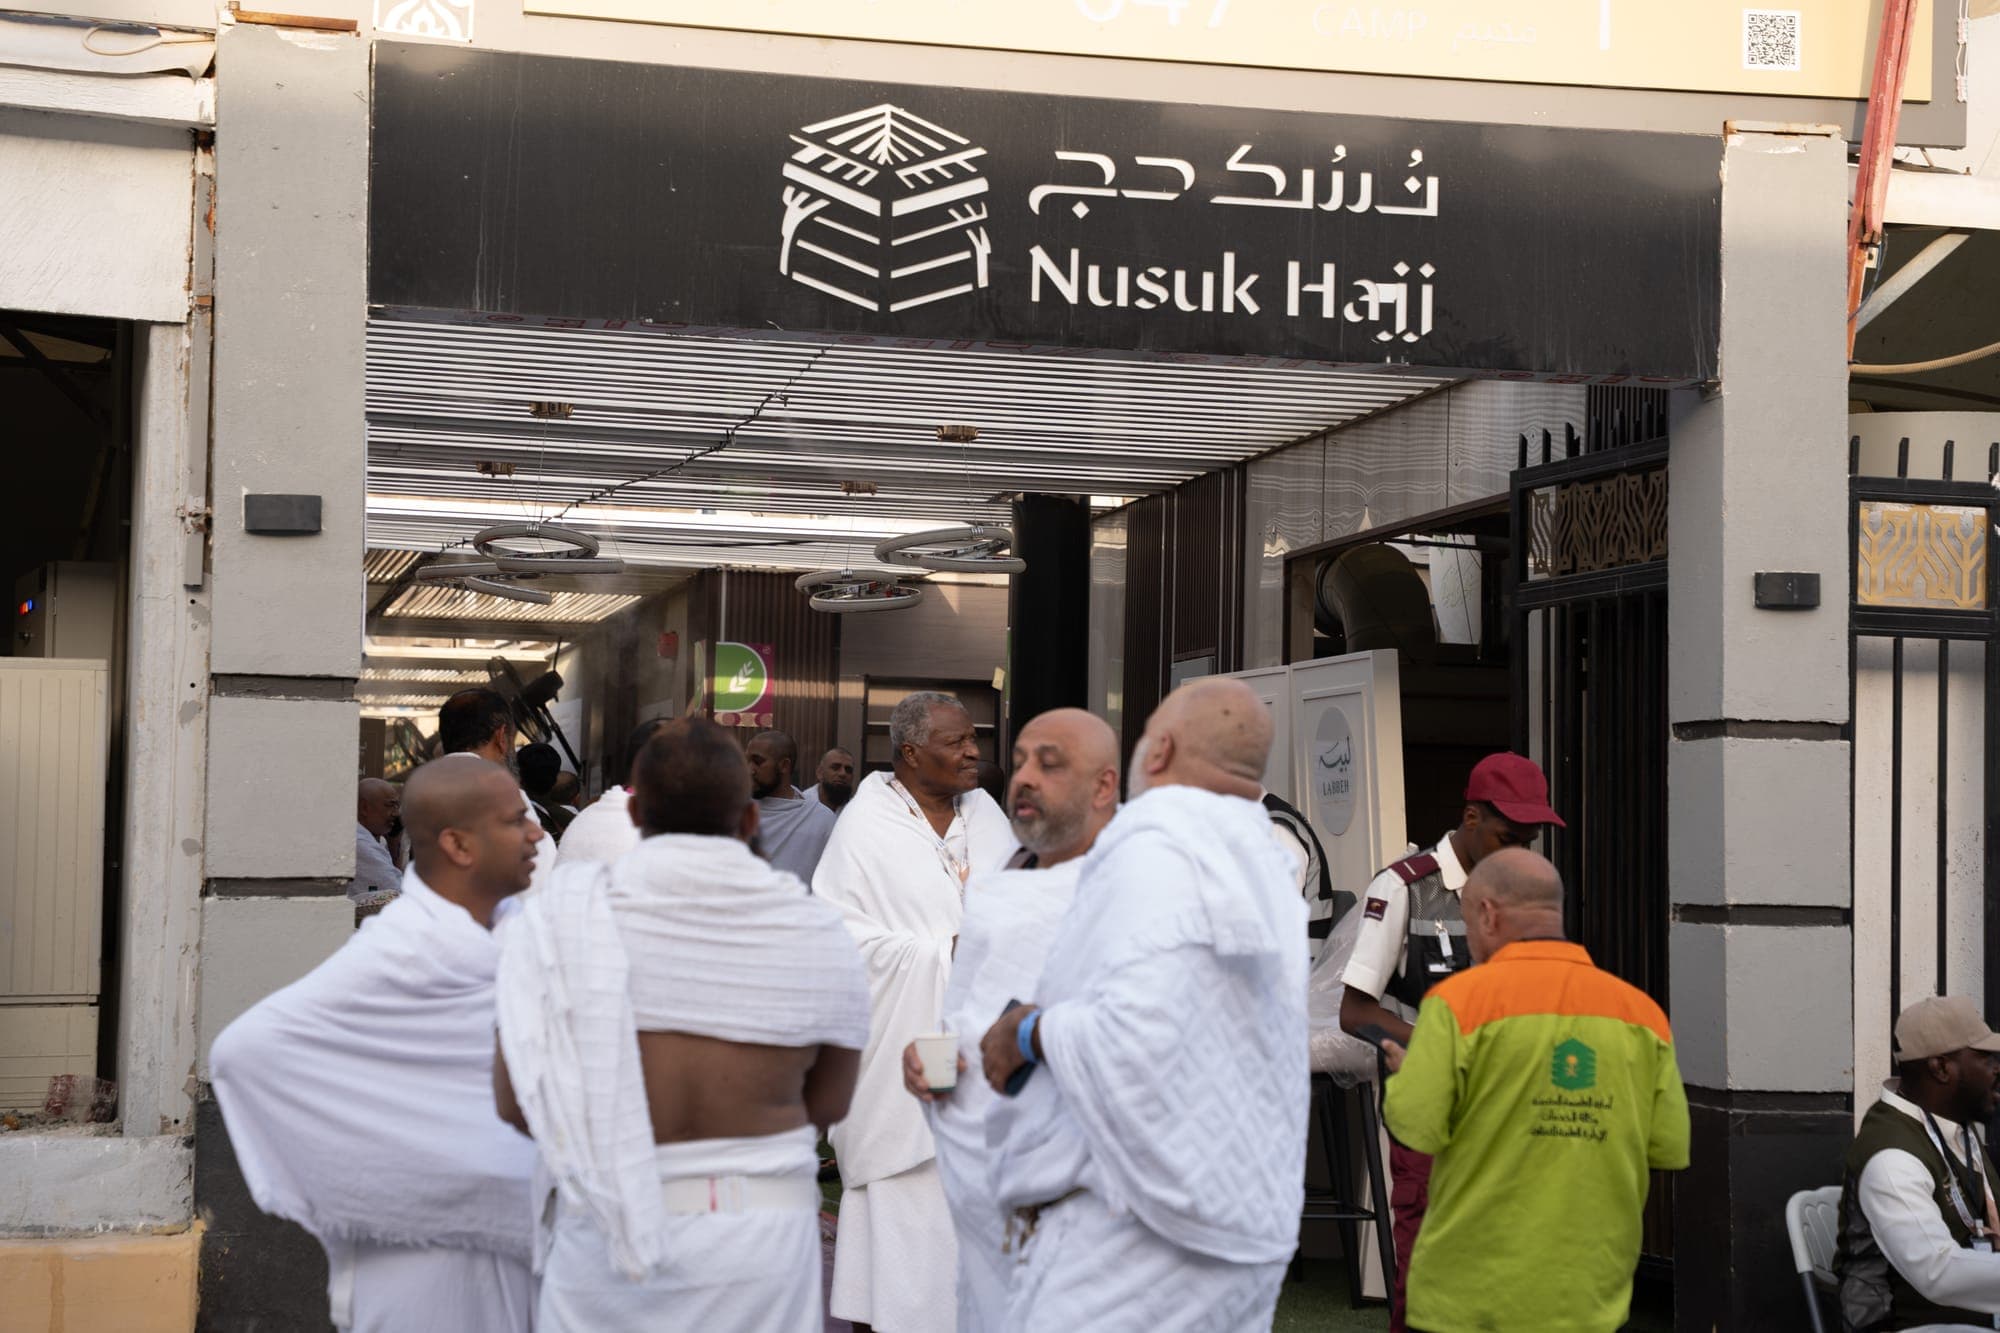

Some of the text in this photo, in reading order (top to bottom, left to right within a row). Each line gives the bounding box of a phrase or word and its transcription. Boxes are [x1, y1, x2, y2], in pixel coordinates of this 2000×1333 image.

[1312, 3, 1429, 43] CAMP
[1028, 150, 1196, 219] حج
[1029, 245, 1435, 343] Nusuk Hajj
[1323, 779, 1350, 796] LABBEH
